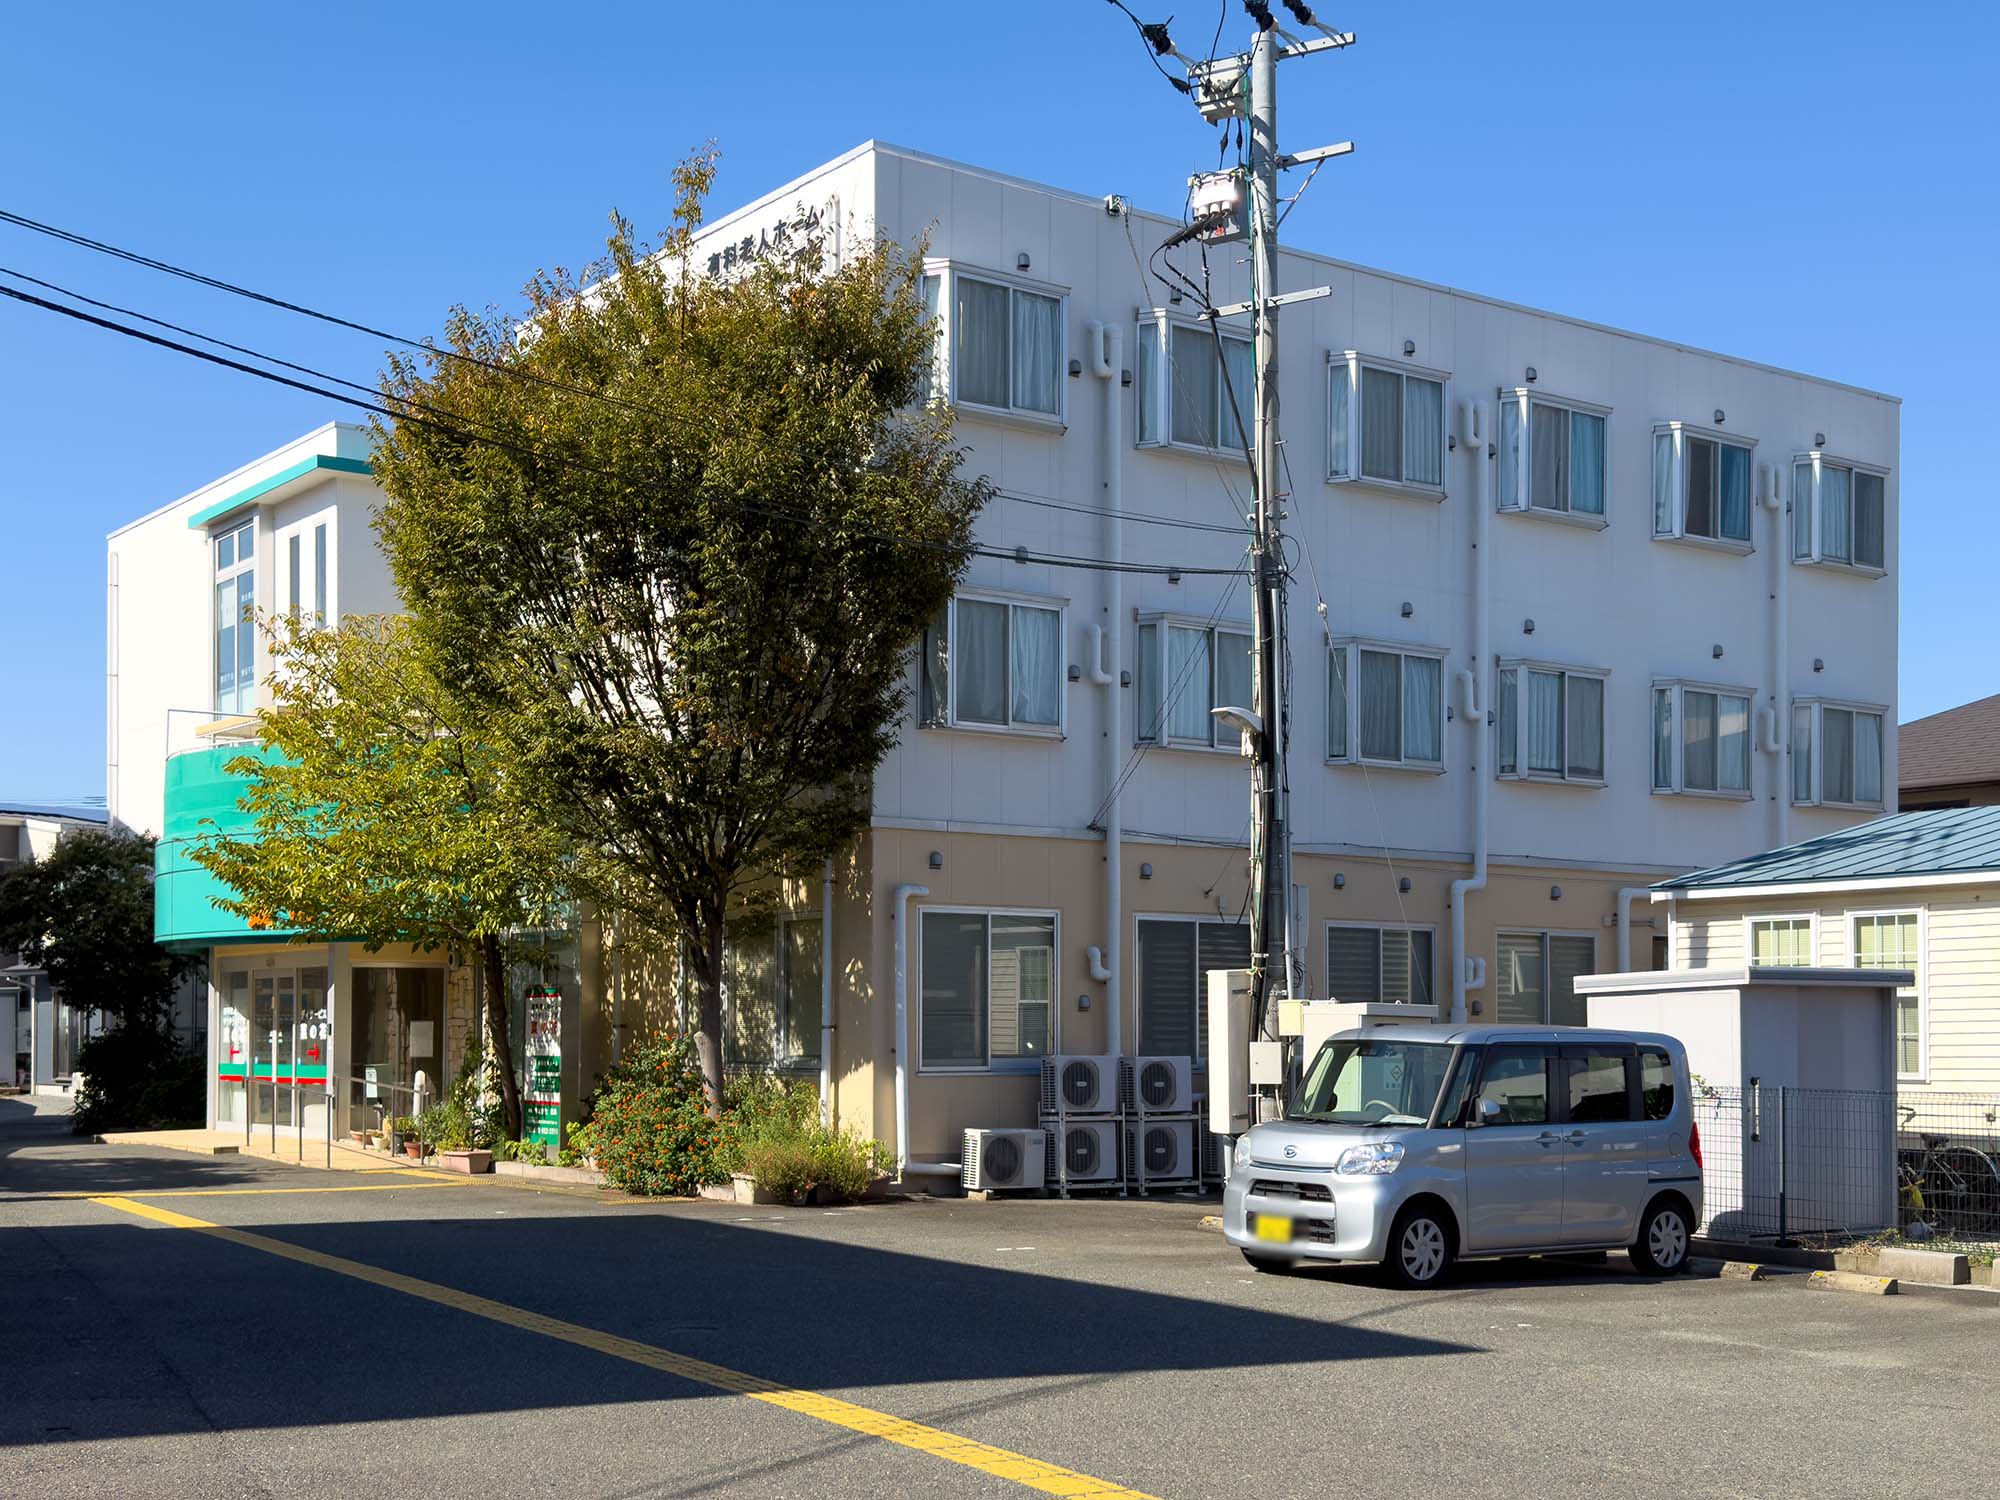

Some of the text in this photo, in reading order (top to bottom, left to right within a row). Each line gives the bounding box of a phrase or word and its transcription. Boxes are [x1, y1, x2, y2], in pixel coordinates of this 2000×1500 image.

[707, 204, 821, 277] 有料老人ホーム
